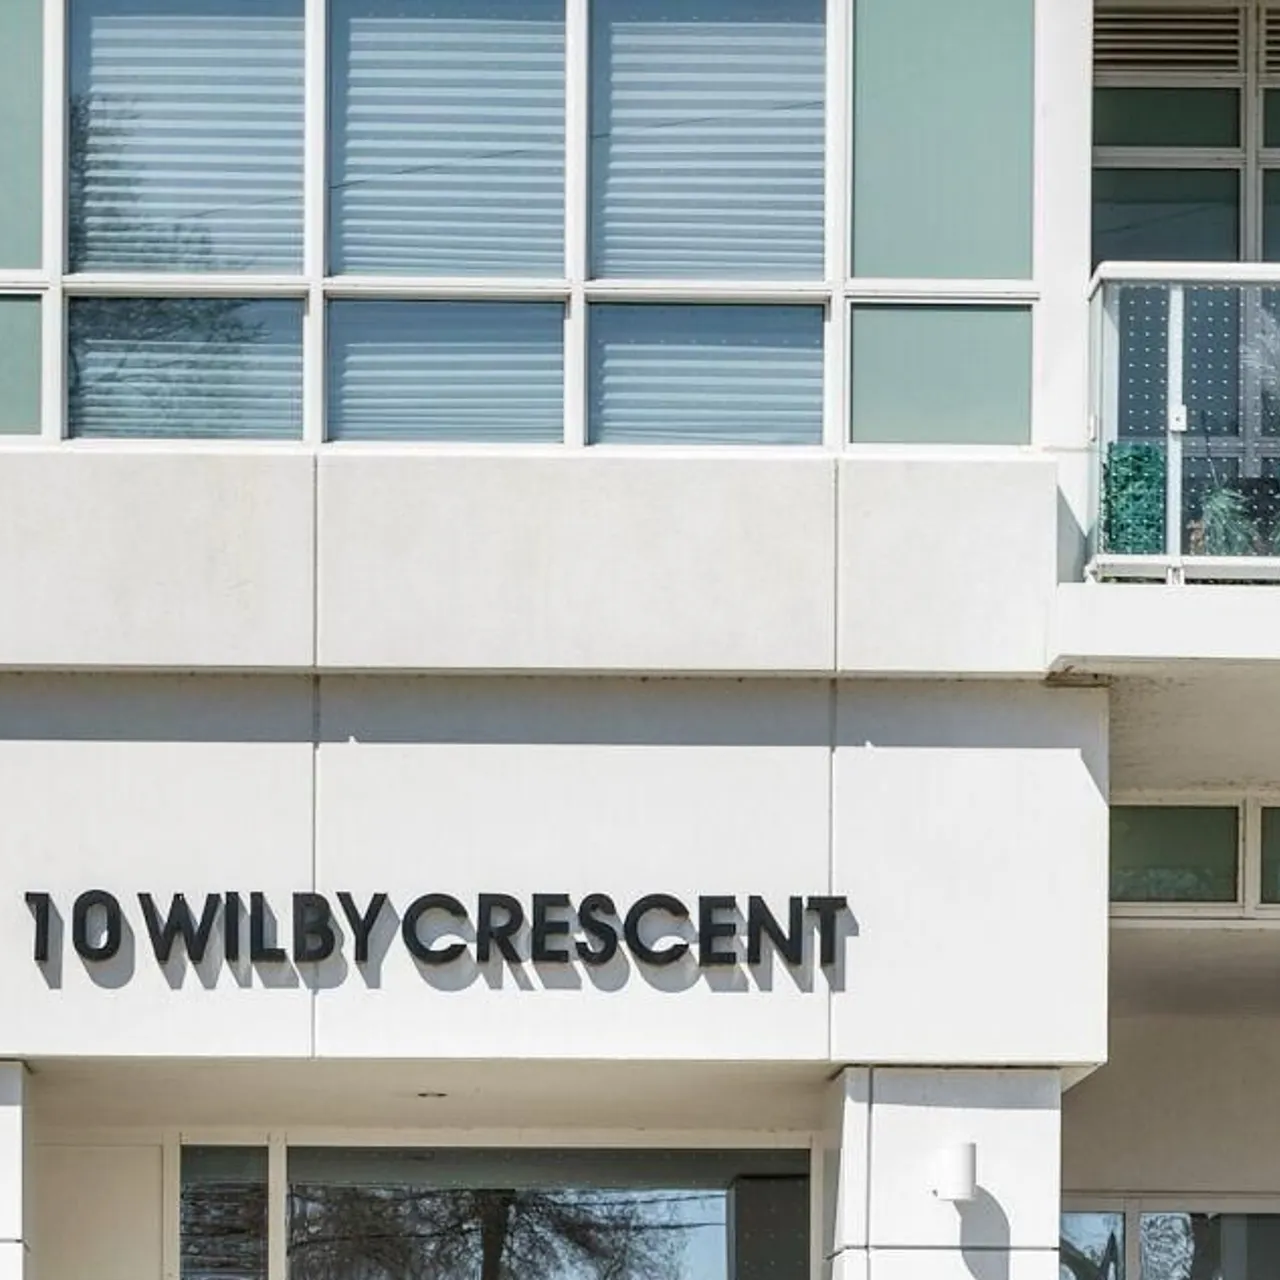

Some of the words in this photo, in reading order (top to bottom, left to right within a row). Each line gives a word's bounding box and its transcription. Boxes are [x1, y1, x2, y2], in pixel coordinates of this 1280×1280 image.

[25, 889, 120, 963] 10
[137, 891, 388, 964] WILBY
[401, 893, 848, 967] CRESCENT
